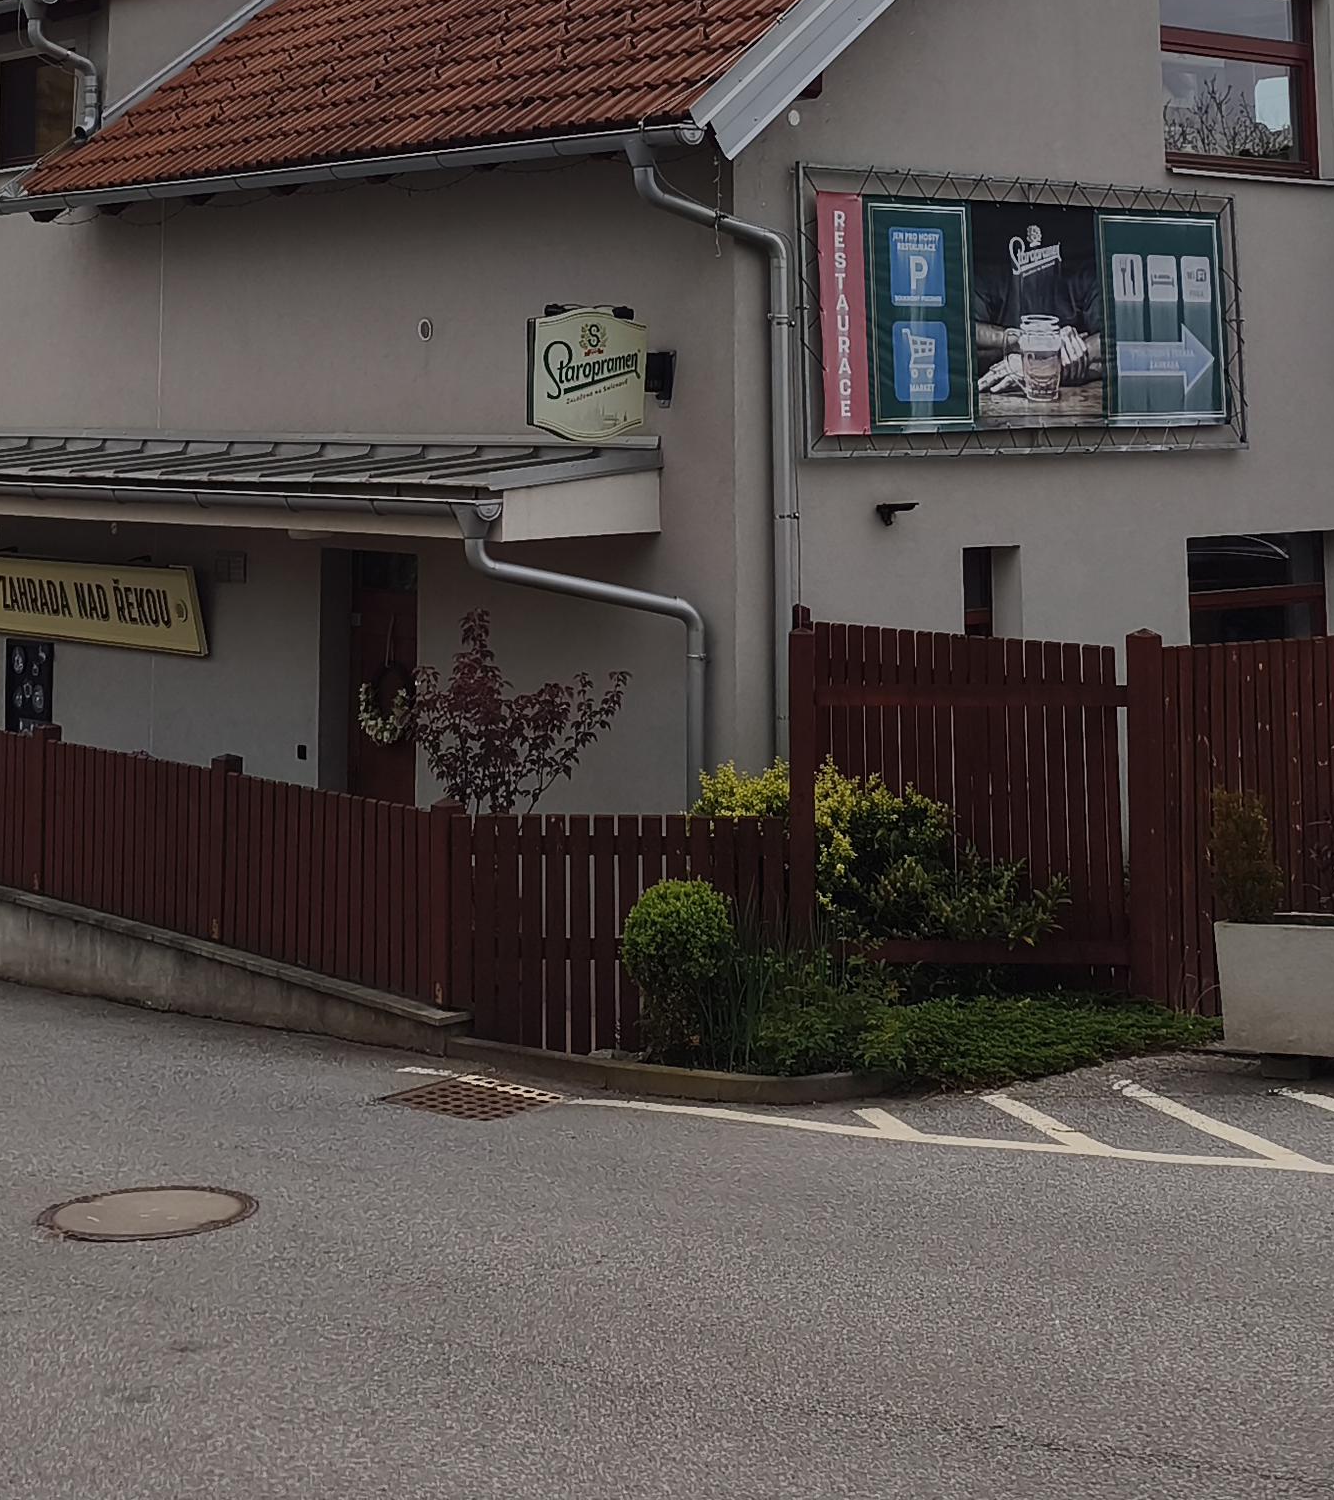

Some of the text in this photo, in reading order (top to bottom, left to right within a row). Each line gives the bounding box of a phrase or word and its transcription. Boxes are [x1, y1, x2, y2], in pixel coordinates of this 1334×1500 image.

[909, 255, 928, 290] P
[833, 210, 852, 417] RESTAURACE
[543, 341, 641, 400] Staropramen
[73, 582, 109, 622] NAD
[112, 578, 172, 629] ŘEKOU
